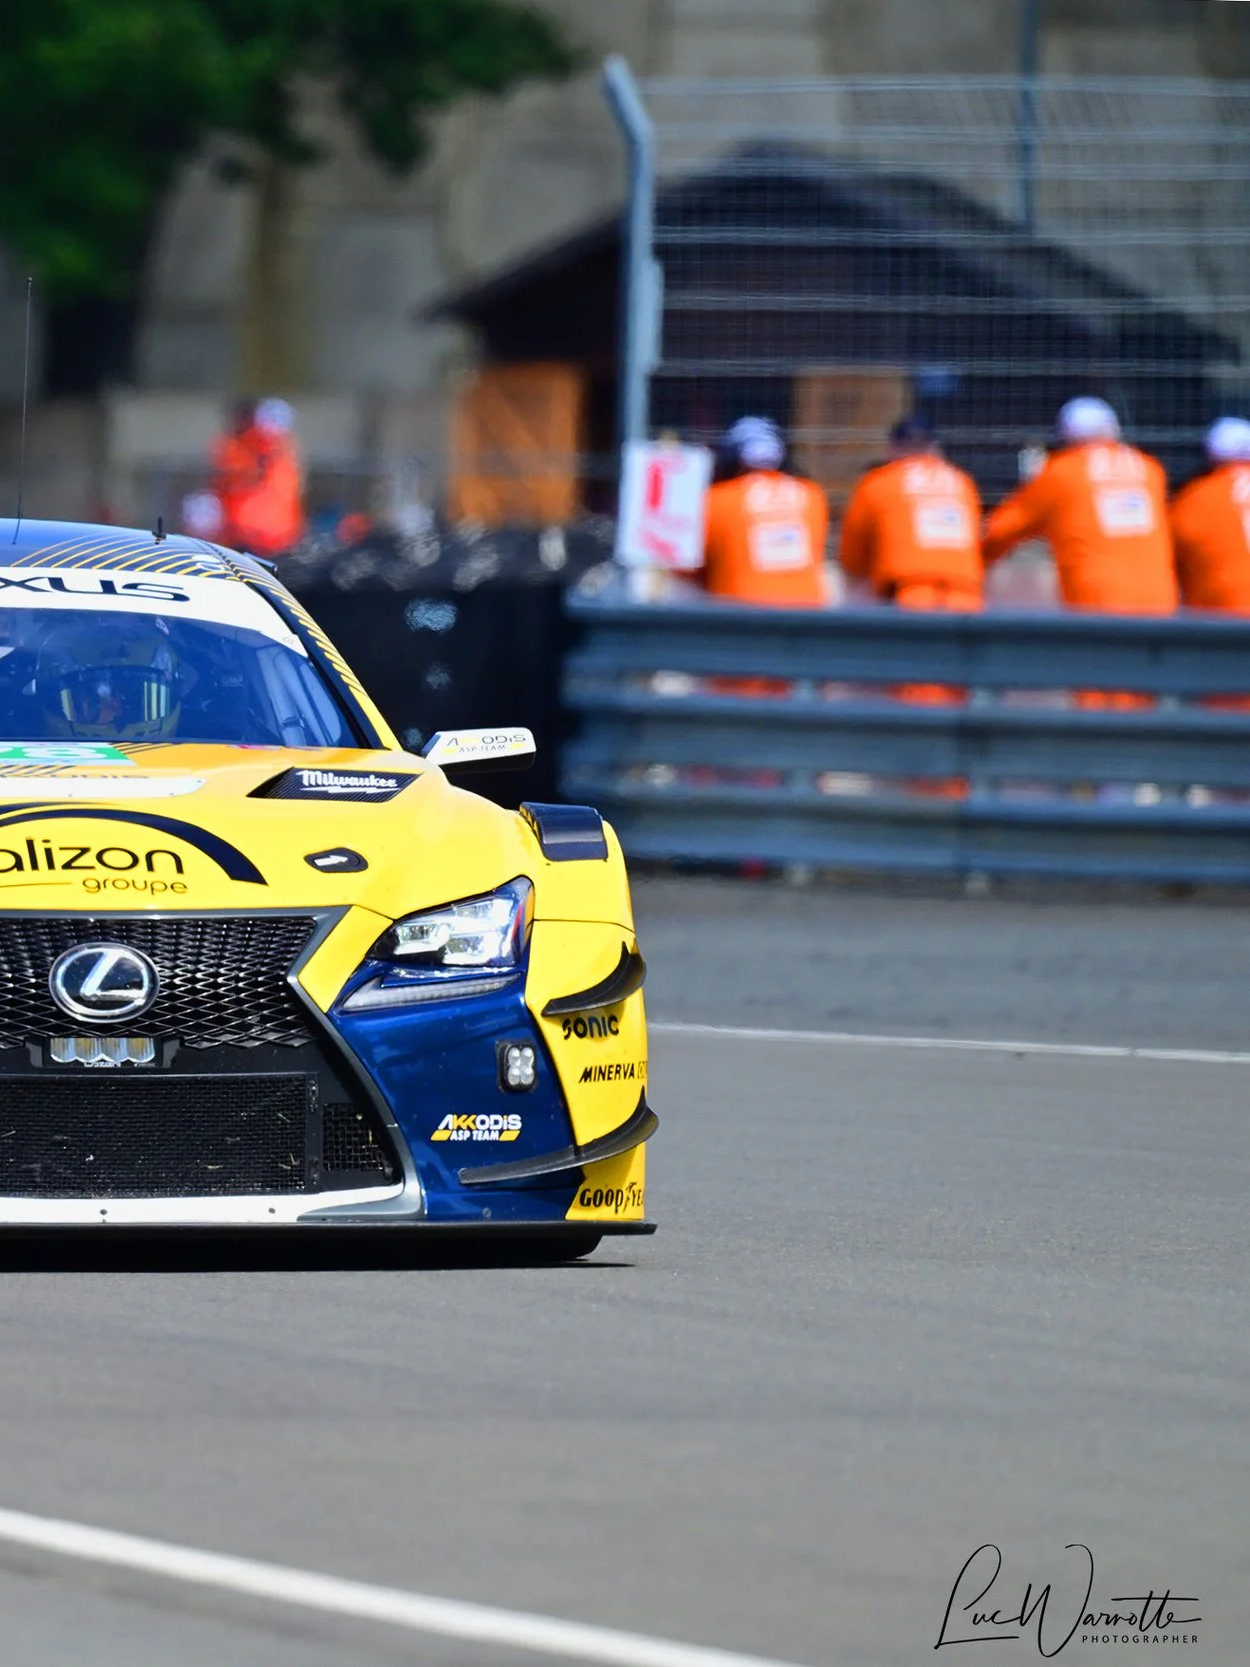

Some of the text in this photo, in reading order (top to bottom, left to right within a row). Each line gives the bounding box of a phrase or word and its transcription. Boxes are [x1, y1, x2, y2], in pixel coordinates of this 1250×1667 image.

[447, 734, 526, 746] AODiS
[296, 769, 398, 789] Milwaukee
[82, 878, 188, 895] groupe
[578, 1063, 635, 1084] MINERVA
[450, 1130, 499, 1141] ASP TEAM
[579, 1184, 644, 1214] GOODYE
